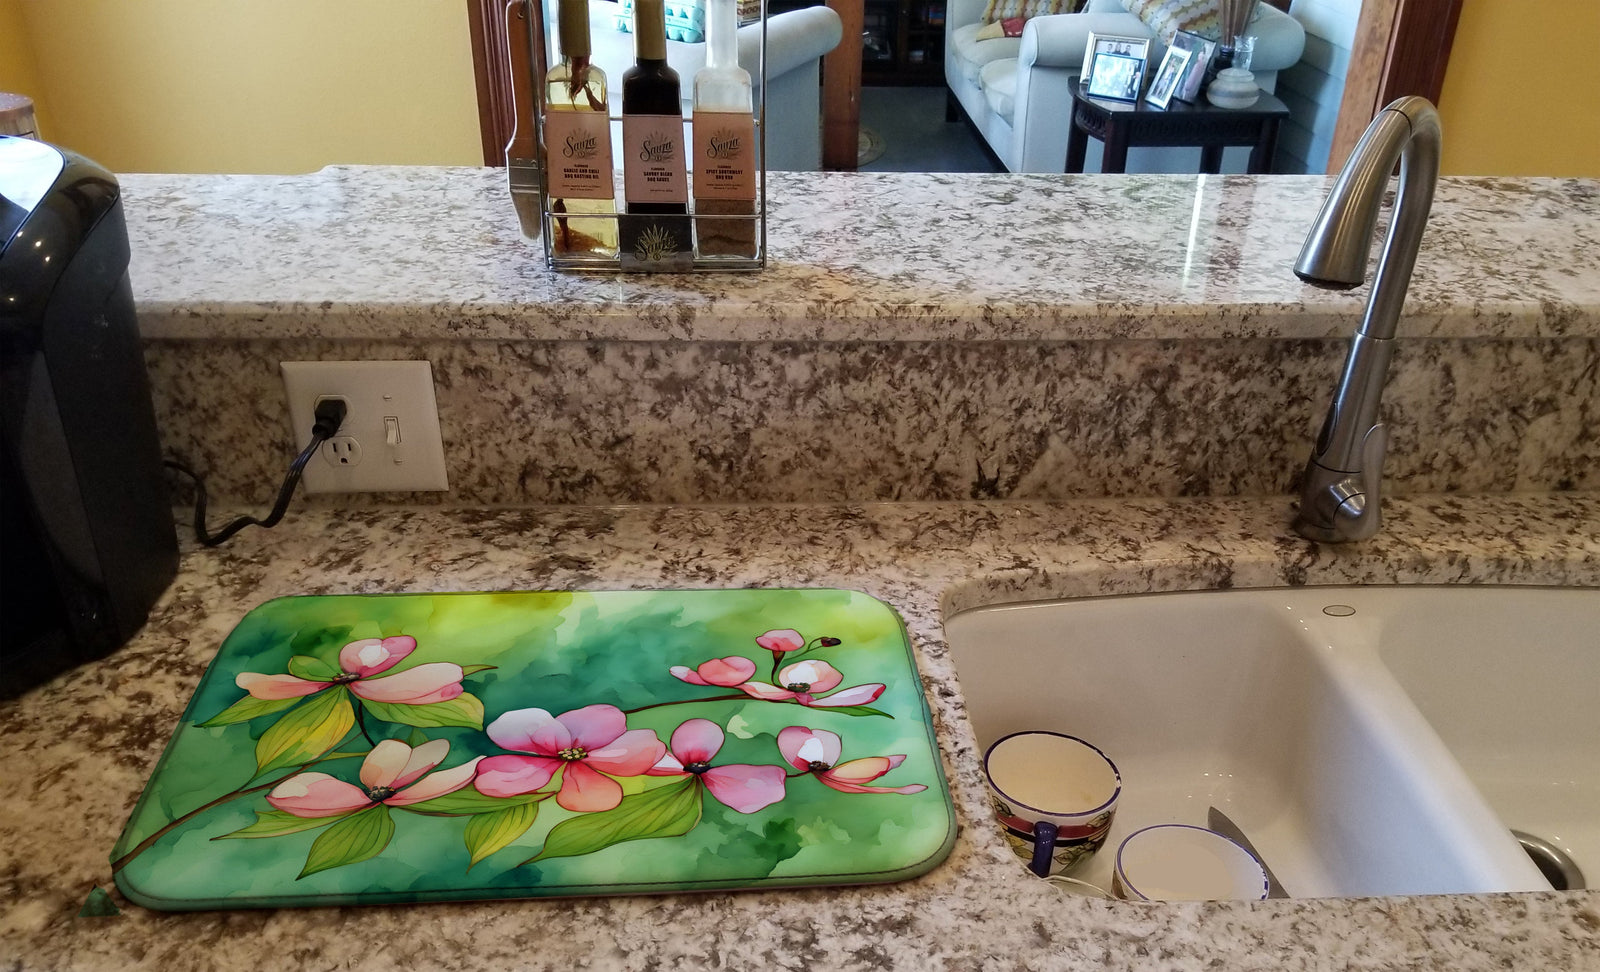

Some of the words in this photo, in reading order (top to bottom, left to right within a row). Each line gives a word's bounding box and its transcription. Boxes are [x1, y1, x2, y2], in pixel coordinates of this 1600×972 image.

[563, 136, 597, 158] Sauza
[640, 140, 674, 162] Sauza
[707, 136, 740, 159] Sauza
